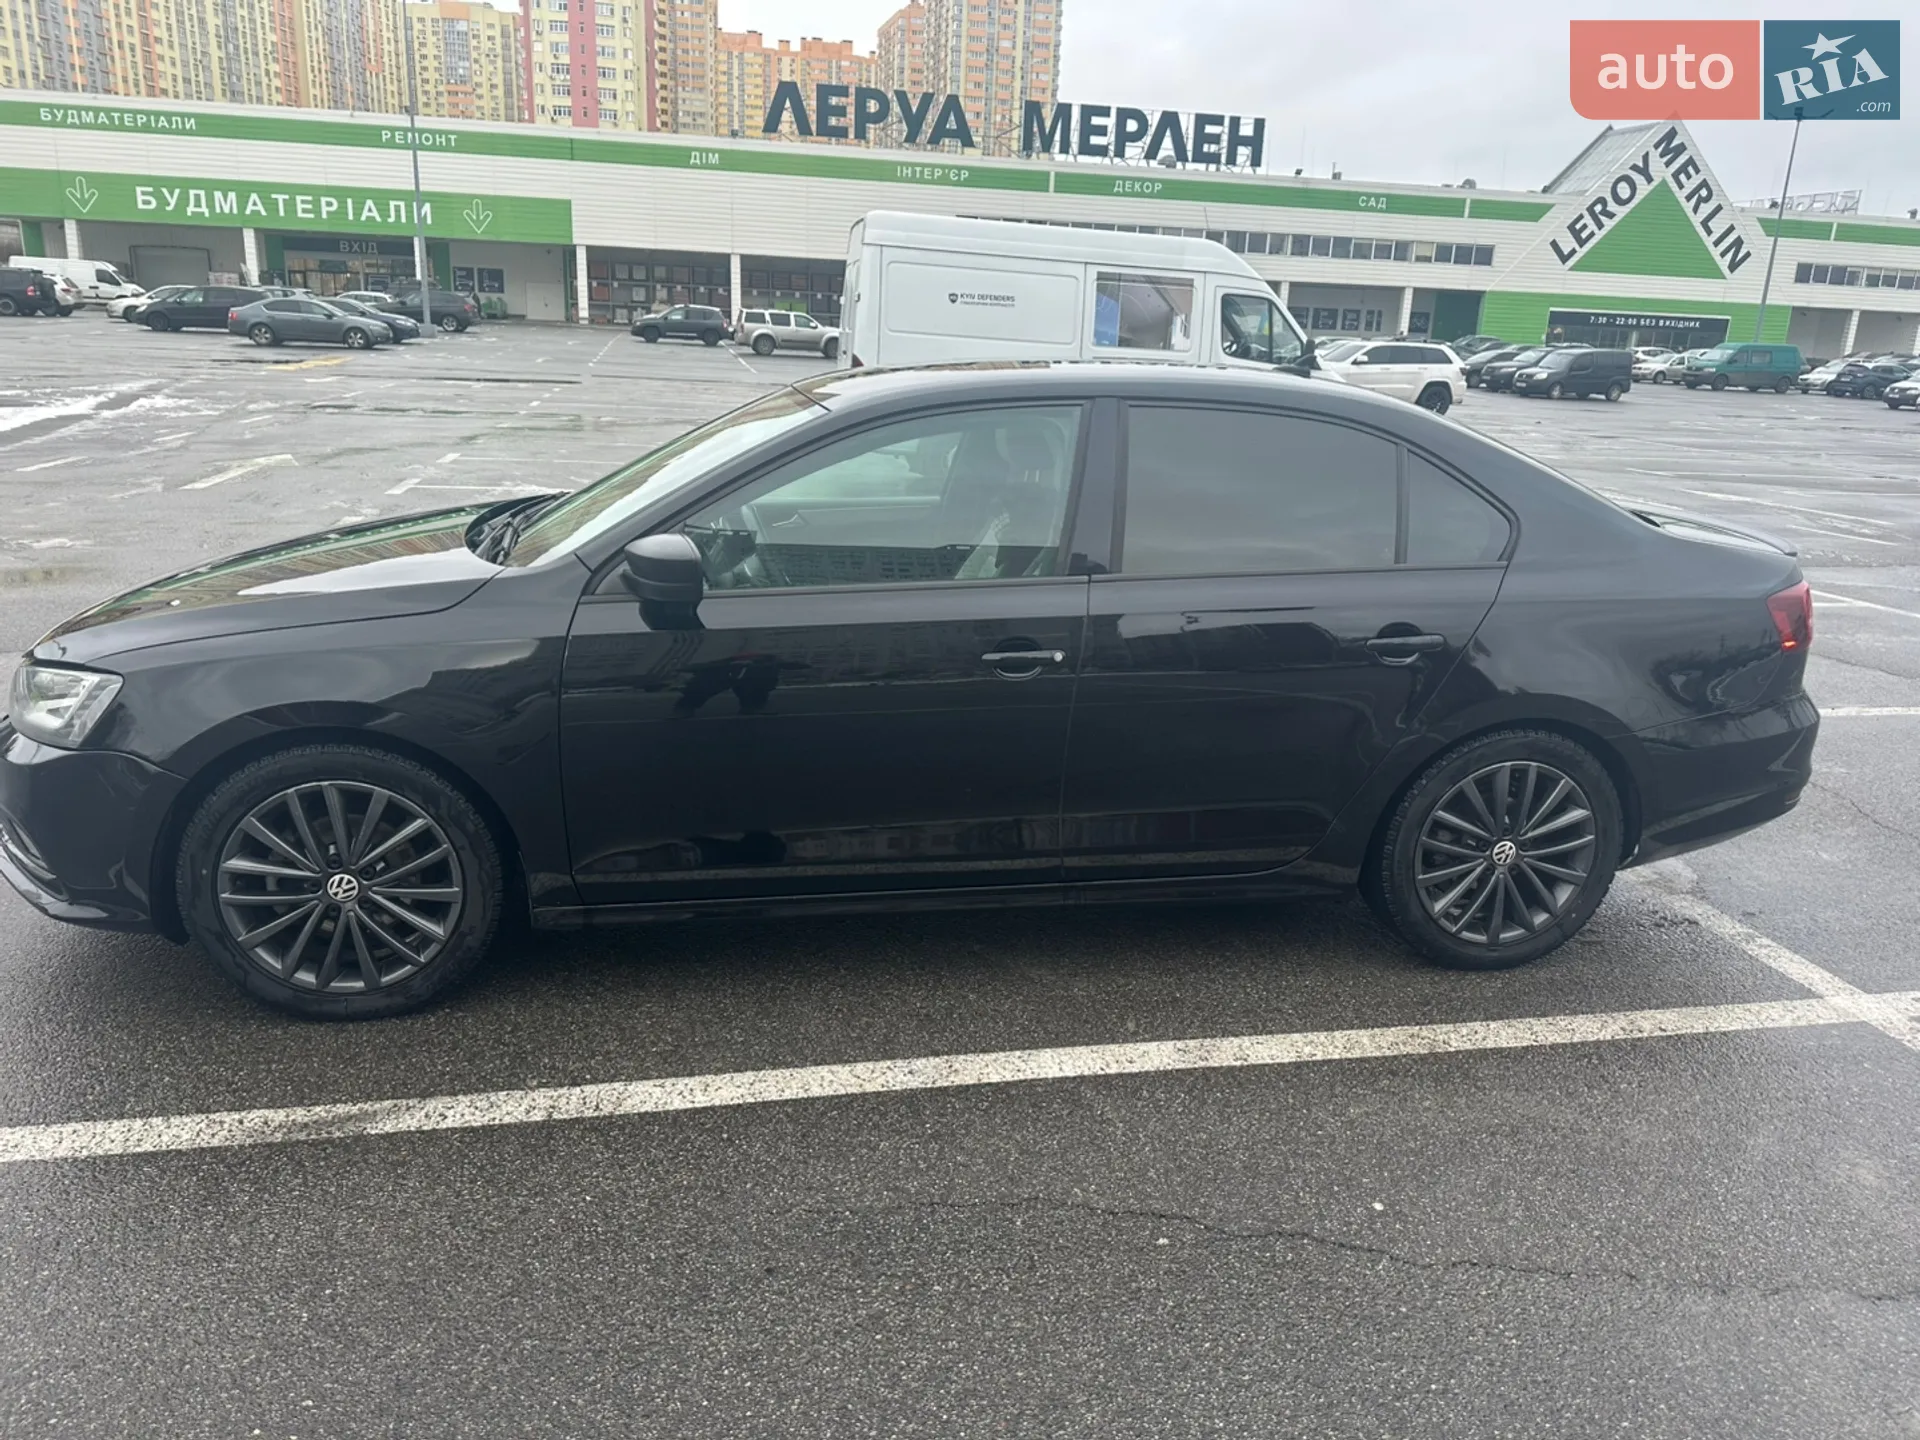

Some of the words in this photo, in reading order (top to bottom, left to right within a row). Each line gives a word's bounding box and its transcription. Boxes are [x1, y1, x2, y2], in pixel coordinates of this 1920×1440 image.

[39, 107, 196, 130] БУДМАТЕРІАЛИ
[762, 81, 976, 149] ЛЕРУА
[1022, 100, 1266, 168] МЕРЛЕН
[381, 130, 457, 147] РЕМОНТ
[689, 151, 719, 165] ДІМ
[897, 166, 969, 182] ІНТЕР'ЄР
[1113, 179, 1162, 194] ДЕКОР
[135, 185, 433, 225] БУДМАТЕРІАЛИ
[1358, 196, 1387, 209] САД
[1549, 150, 1654, 265] LEROY
[1653, 125, 1751, 274] MERLIN
[339, 239, 378, 254] ВХІД
